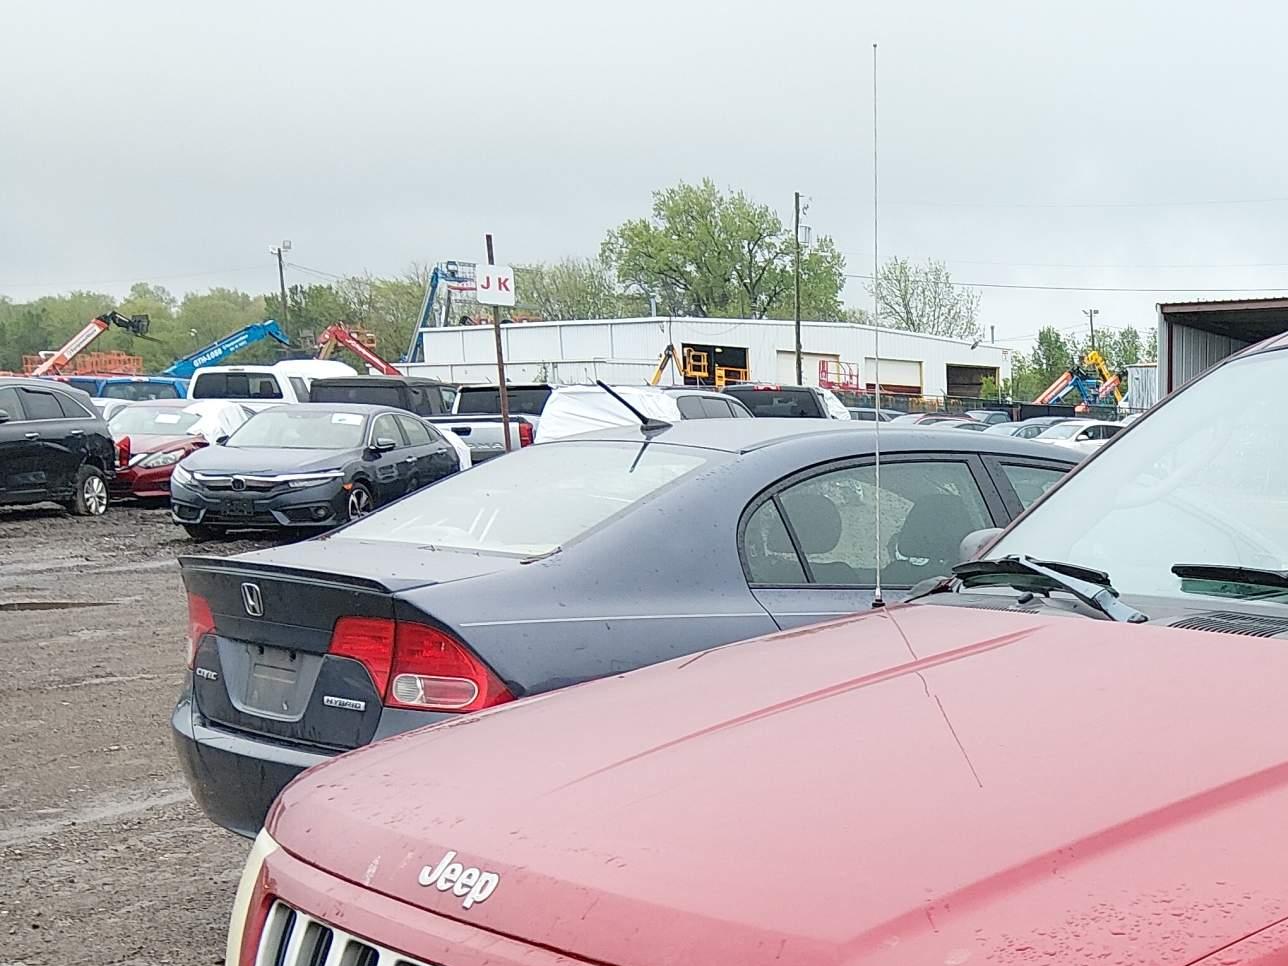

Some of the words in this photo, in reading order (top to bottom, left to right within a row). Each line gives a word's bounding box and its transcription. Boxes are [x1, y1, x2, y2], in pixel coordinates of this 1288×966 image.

[480, 275, 491, 290] J
[497, 276, 511, 292] K
[196, 667, 218, 680] CIVIC
[325, 696, 363, 710] HYBRID
[418, 850, 500, 910] Jeep
